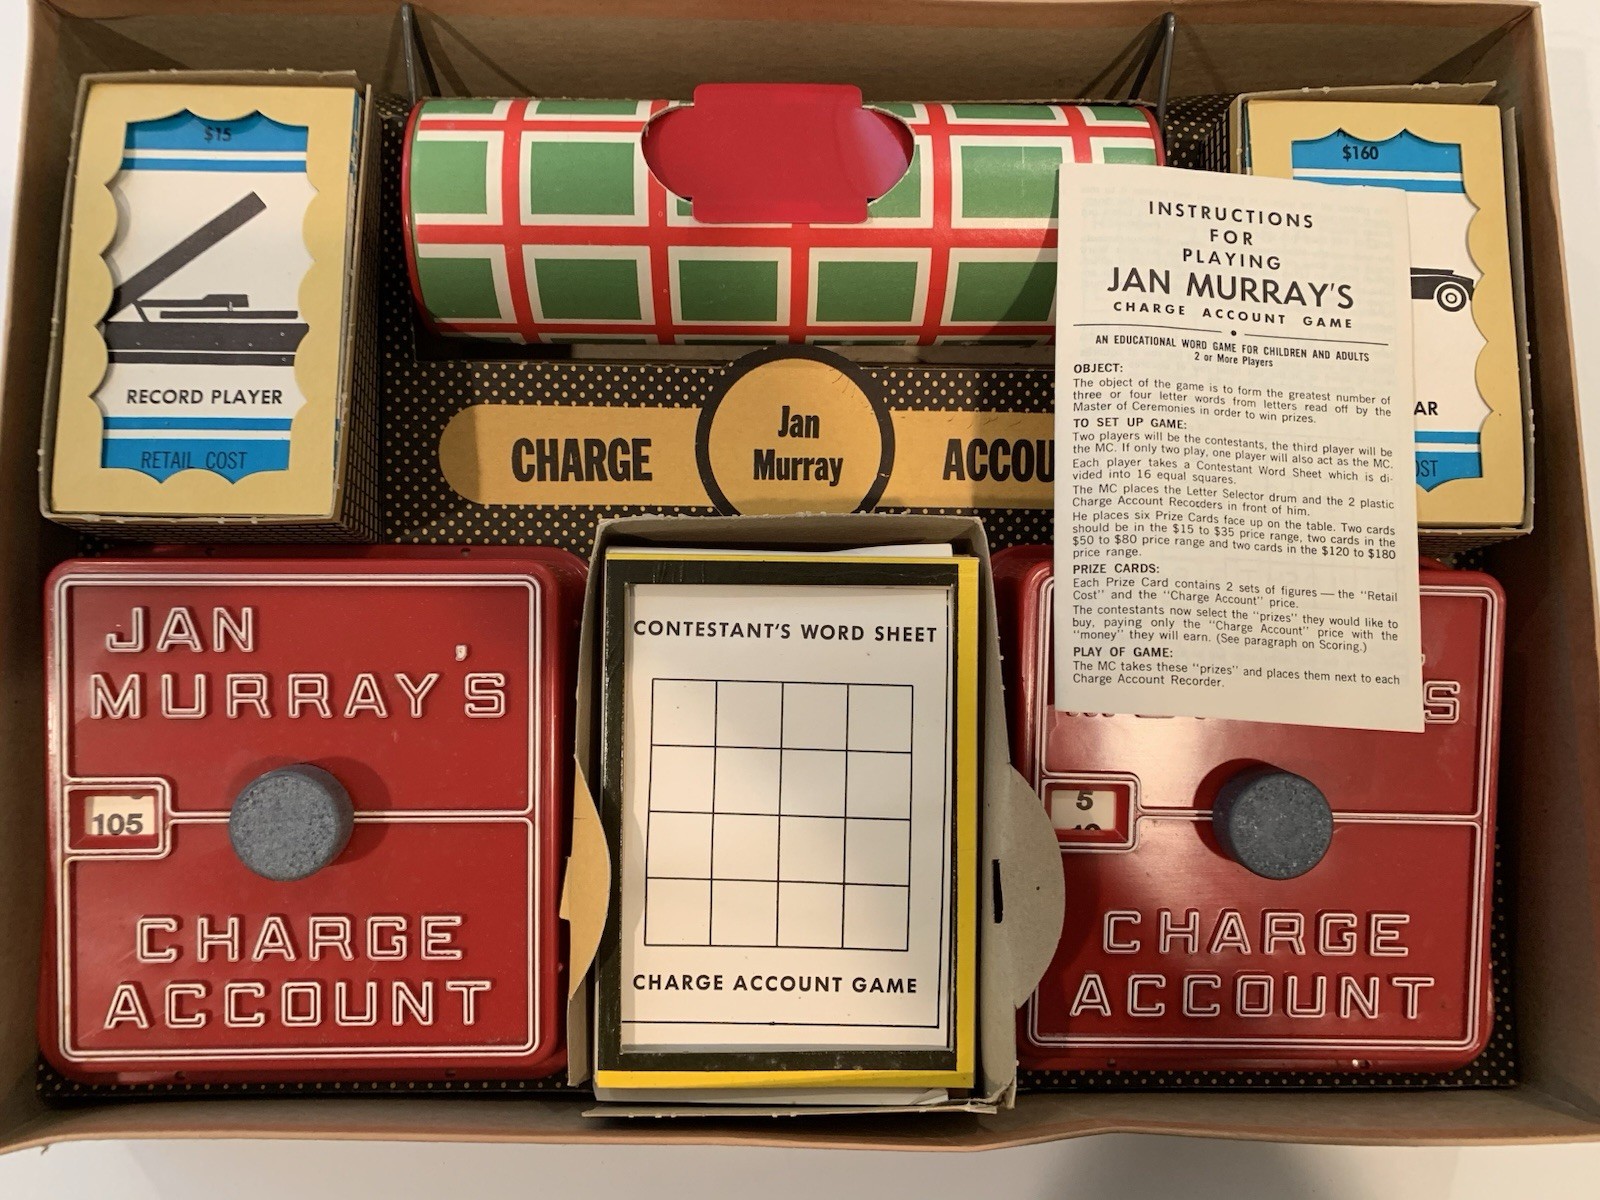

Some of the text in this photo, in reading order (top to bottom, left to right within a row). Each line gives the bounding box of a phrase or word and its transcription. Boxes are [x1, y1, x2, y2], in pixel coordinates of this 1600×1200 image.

[204, 126, 231, 142] $15
[1342, 144, 1378, 162] $160
[1149, 201, 1314, 228] INSTRUCTIONS
[1210, 229, 1253, 245] FOR
[1183, 249, 1281, 270] PLAYING
[1108, 267, 1354, 309] JAN MURRAY'S
[1113, 301, 1352, 329] CHARGE ACCOUNT GAME
[1096, 335, 1369, 362] AN EDUCATIONAL WORD GAME FOR CHILDREN AND ADULTS
[1194, 352, 1200, 361] 2
[1216, 353, 1238, 365] More
[1242, 355, 1273, 368] Players
[1073, 362, 1123, 374] OBJECT:
[126, 390, 282, 404] RECORD PLAYER
[1073, 377, 1390, 405] The object of the game is to form the greatest number of
[1073, 389, 1391, 417] three or four letter words from letters read off by the
[778, 406, 820, 440] Jan
[1073, 400, 1316, 423] Master of Ceremonies in order to win prizes.
[1073, 416, 1187, 430] TO SET UP GAME:
[1072, 430, 1393, 457] Two players will be the contestants, the third player will be
[1073, 442, 1393, 469] the MC. If only two play, one player will also act as the MC.
[142, 452, 248, 469] RETAIL COST
[512, 438, 1054, 482] CHARGE ACCOU
[753, 449, 843, 487] Murray
[1072, 457, 1393, 483] Each player takes a Contestant Word Sheet which is di-
[1072, 510, 1396, 536] He places six Prize Cards face up on the table. Two cards
[1072, 533, 1396, 560] $50 to $80 price range and two cards in the $120 to $180
[1072, 562, 1160, 574] PRIZE CARDS:
[106, 606, 254, 653] JAN
[634, 620, 937, 643] CONTESTANT'S WORD SHEET
[1073, 646, 1173, 658] PLAY OF GAME:
[90, 644, 505, 719] MURRAY'S
[1072, 672, 1224, 687] Charge Account Recorder.
[1076, 790, 1094, 810] 5
[91, 813, 144, 835] 105
[136, 914, 463, 963] CHARGE
[1103, 910, 1410, 957] CHARGE
[633, 974, 917, 994] CHARGE ACCOUNT GAME
[1070, 973, 1434, 1020] ACCOUNT
[104, 980, 491, 1029] ACCOUNT
